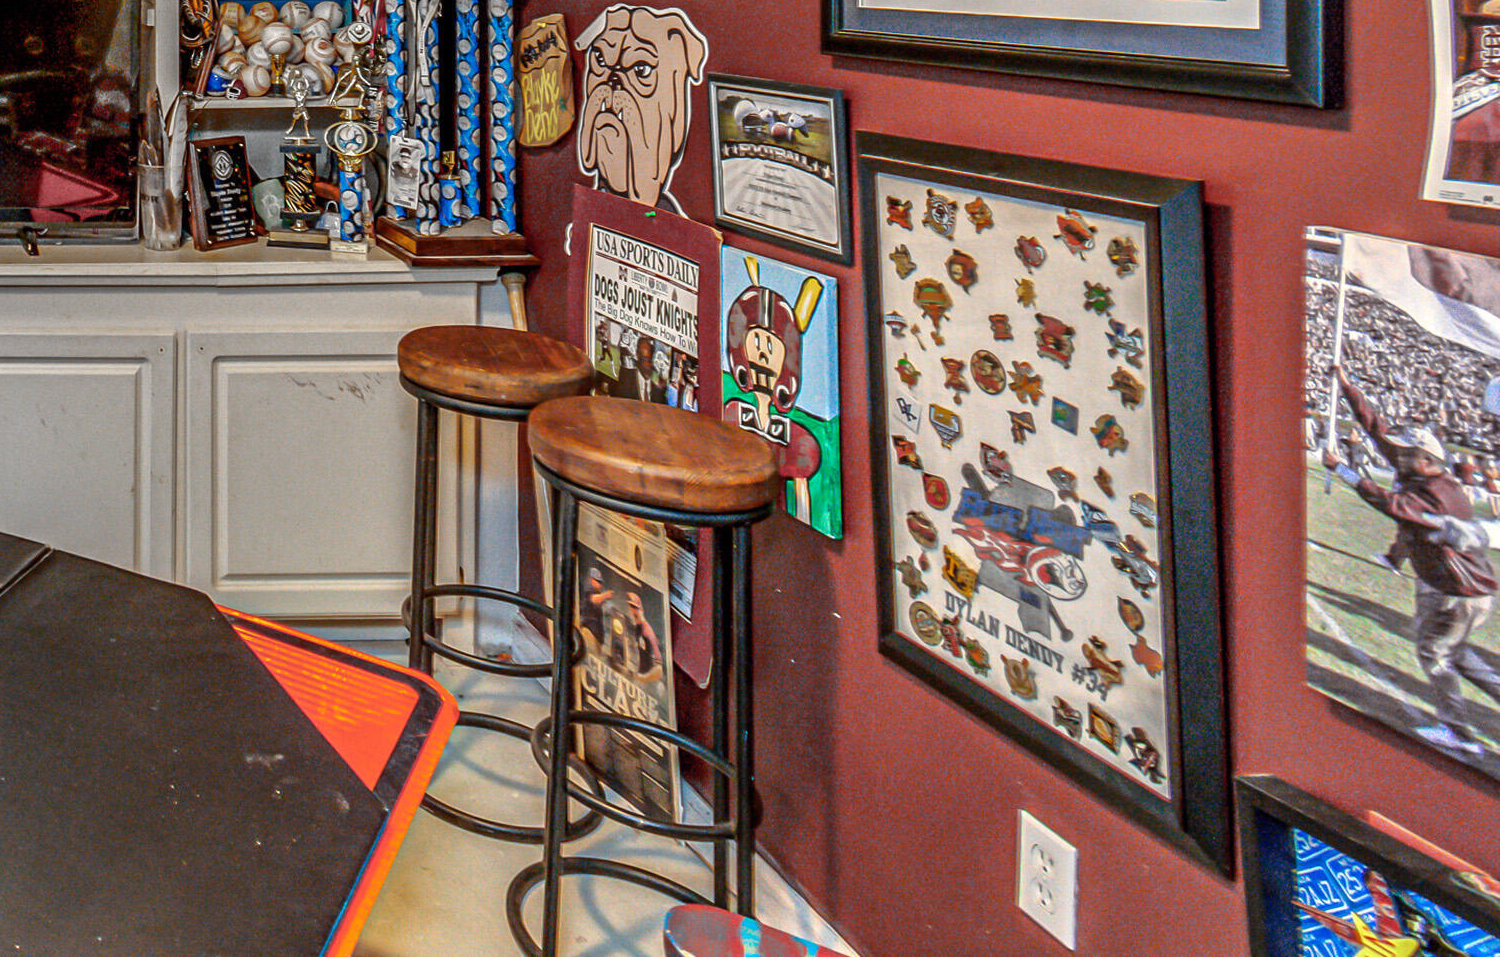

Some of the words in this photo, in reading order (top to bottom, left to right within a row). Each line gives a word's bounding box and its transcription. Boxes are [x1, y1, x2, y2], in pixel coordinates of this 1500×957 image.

[596, 230, 618, 256] USA
[619, 239, 664, 273] SPORTS
[667, 256, 700, 288] DAILY
[594, 273, 619, 305] DOGS
[621, 286, 653, 320] JOUST
[656, 297, 699, 341] KNIGHTS
[594, 297, 606, 311] The
[607, 301, 618, 318] Big
[619, 308, 633, 326] Dog
[635, 315, 659, 336] Knows
[660, 327, 676, 343] How
[678, 334, 687, 348] To
[944, 590, 1001, 640] DYLAN
[1004, 624, 1065, 674] DENDY
